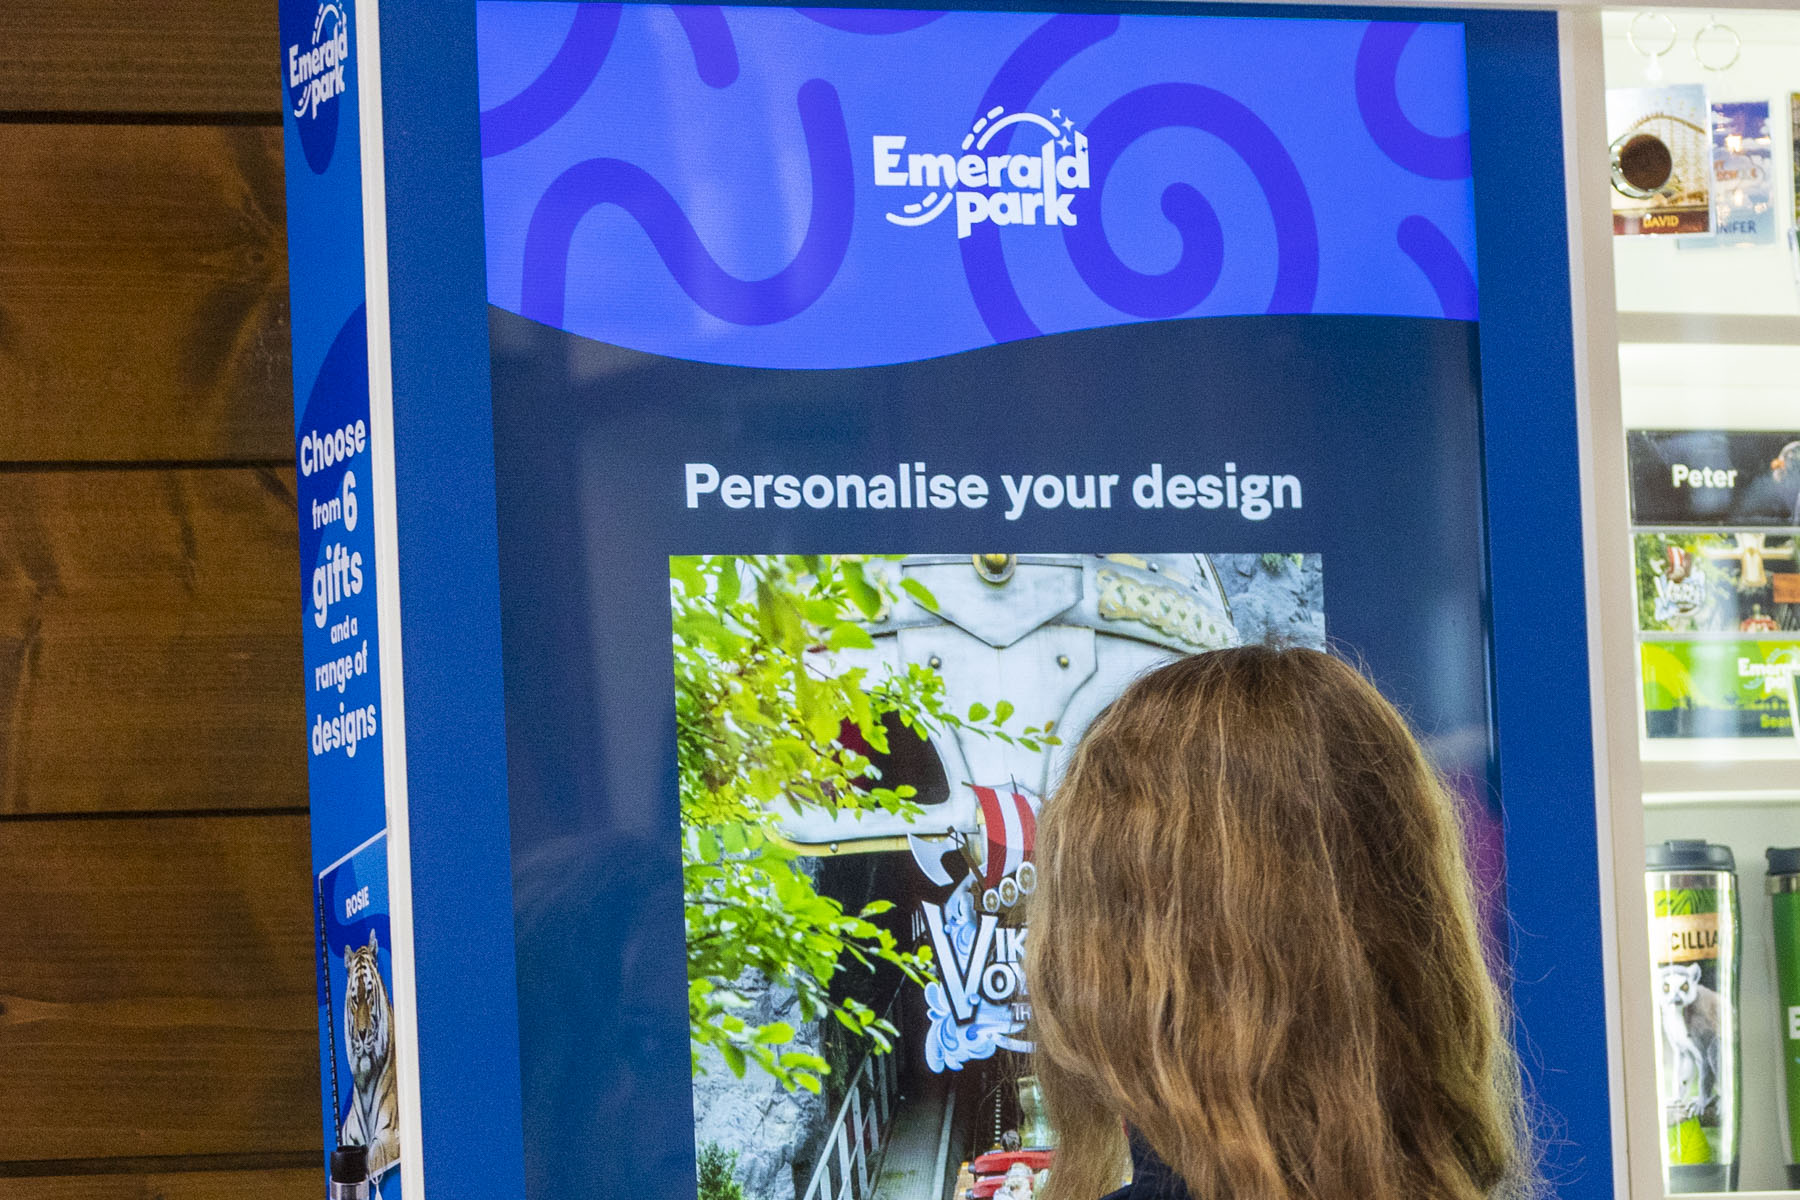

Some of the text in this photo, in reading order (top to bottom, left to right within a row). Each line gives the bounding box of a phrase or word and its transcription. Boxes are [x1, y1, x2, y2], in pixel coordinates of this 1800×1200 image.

[873, 130, 1090, 188] Emerald
[1643, 214, 1680, 229] DAVID
[300, 419, 366, 477] Choose
[1671, 464, 1738, 489] Peter
[312, 470, 358, 532] from 6
[685, 462, 1302, 521] Personalise your design
[313, 542, 364, 629] gifts
[330, 615, 358, 645] and a
[315, 638, 368, 694] range of
[312, 702, 377, 759] designs
[346, 885, 370, 919] ROSIE
